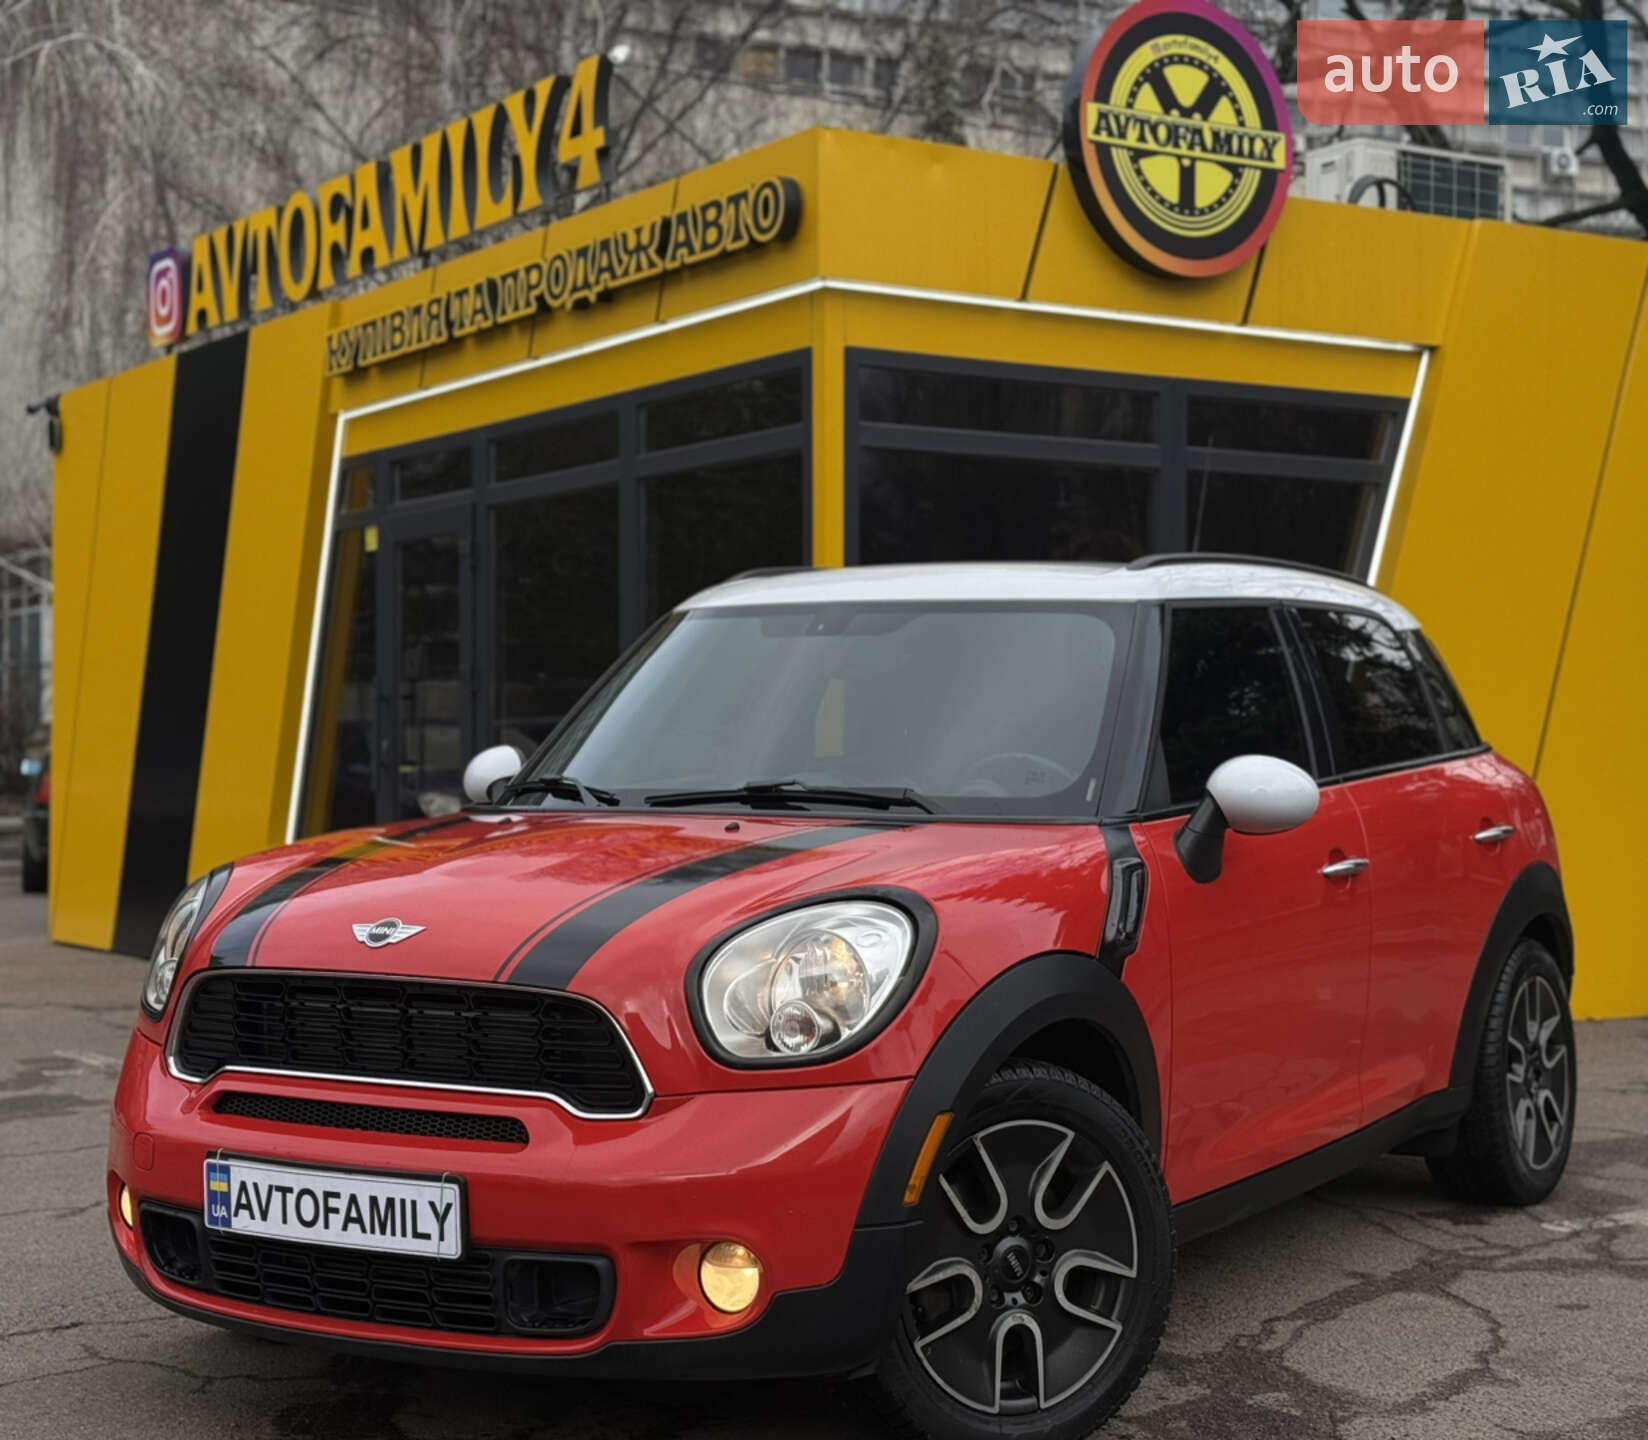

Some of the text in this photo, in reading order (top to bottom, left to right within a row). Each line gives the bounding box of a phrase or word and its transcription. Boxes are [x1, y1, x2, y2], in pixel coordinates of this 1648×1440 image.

[1093, 110, 1282, 163] AVTOFAMILY
[325, 177, 786, 377] КУПІВЛЯ ТА ПРОДАЖ АВТО
[211, 1180, 453, 1242] UA AVTOFAMILY
